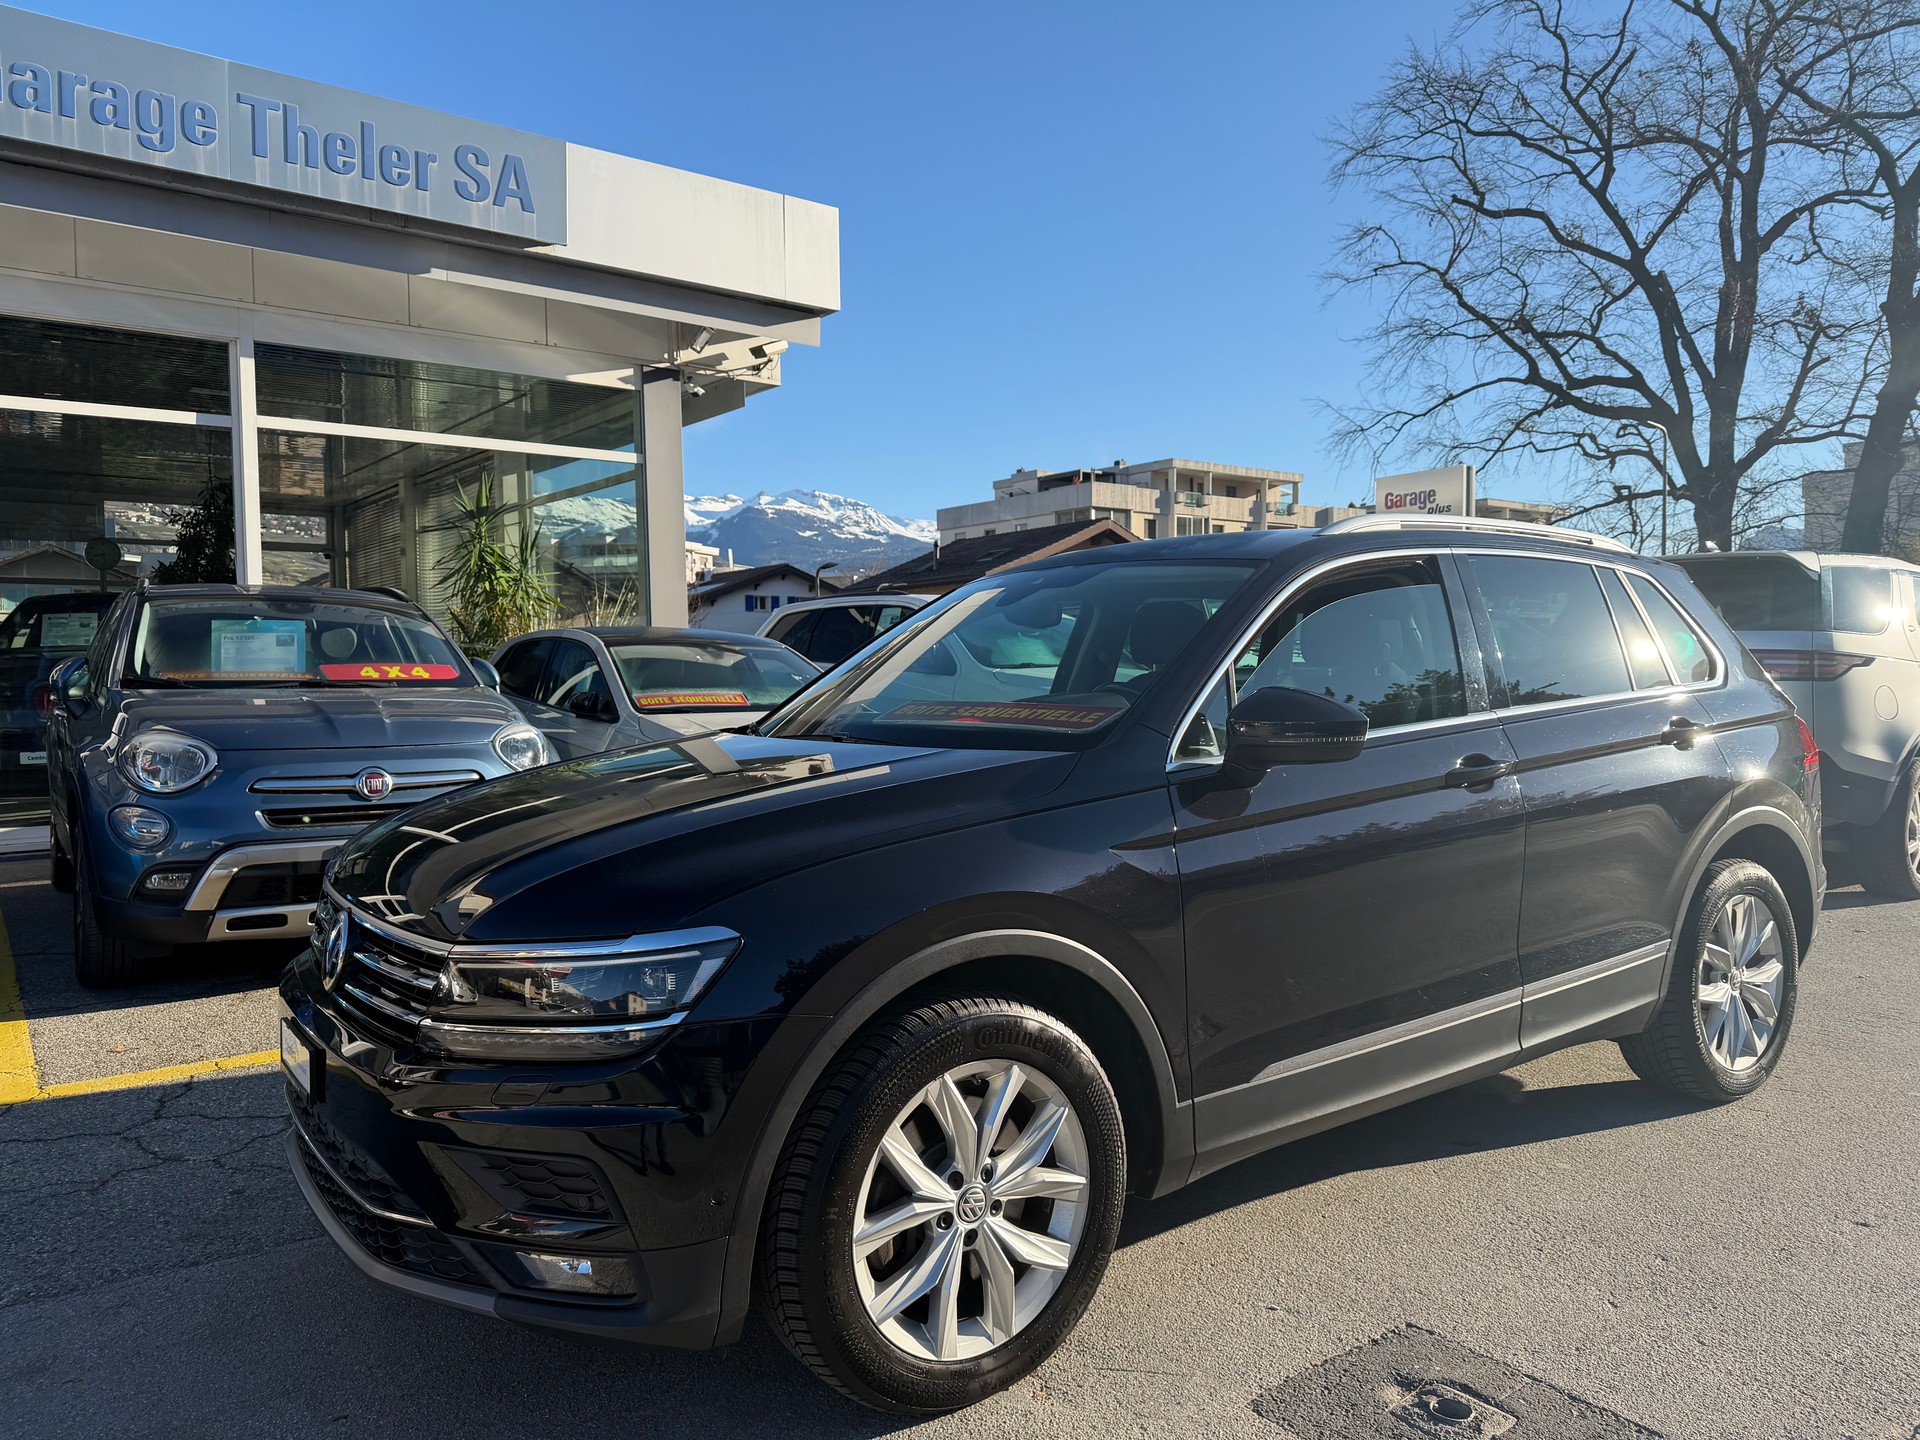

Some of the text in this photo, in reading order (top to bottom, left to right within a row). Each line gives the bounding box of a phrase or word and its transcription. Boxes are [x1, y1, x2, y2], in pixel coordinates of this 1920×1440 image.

[0, 61, 536, 214] arage Theler SA
[1385, 489, 1436, 510] Garage
[1427, 503, 1452, 514] plus
[360, 666, 430, 678] 4X4
[640, 694, 743, 705] BOITE SEQUENTIELLE
[897, 704, 1105, 723] BOITE SEQUENTIELLE
[367, 778, 383, 790] FIAT
